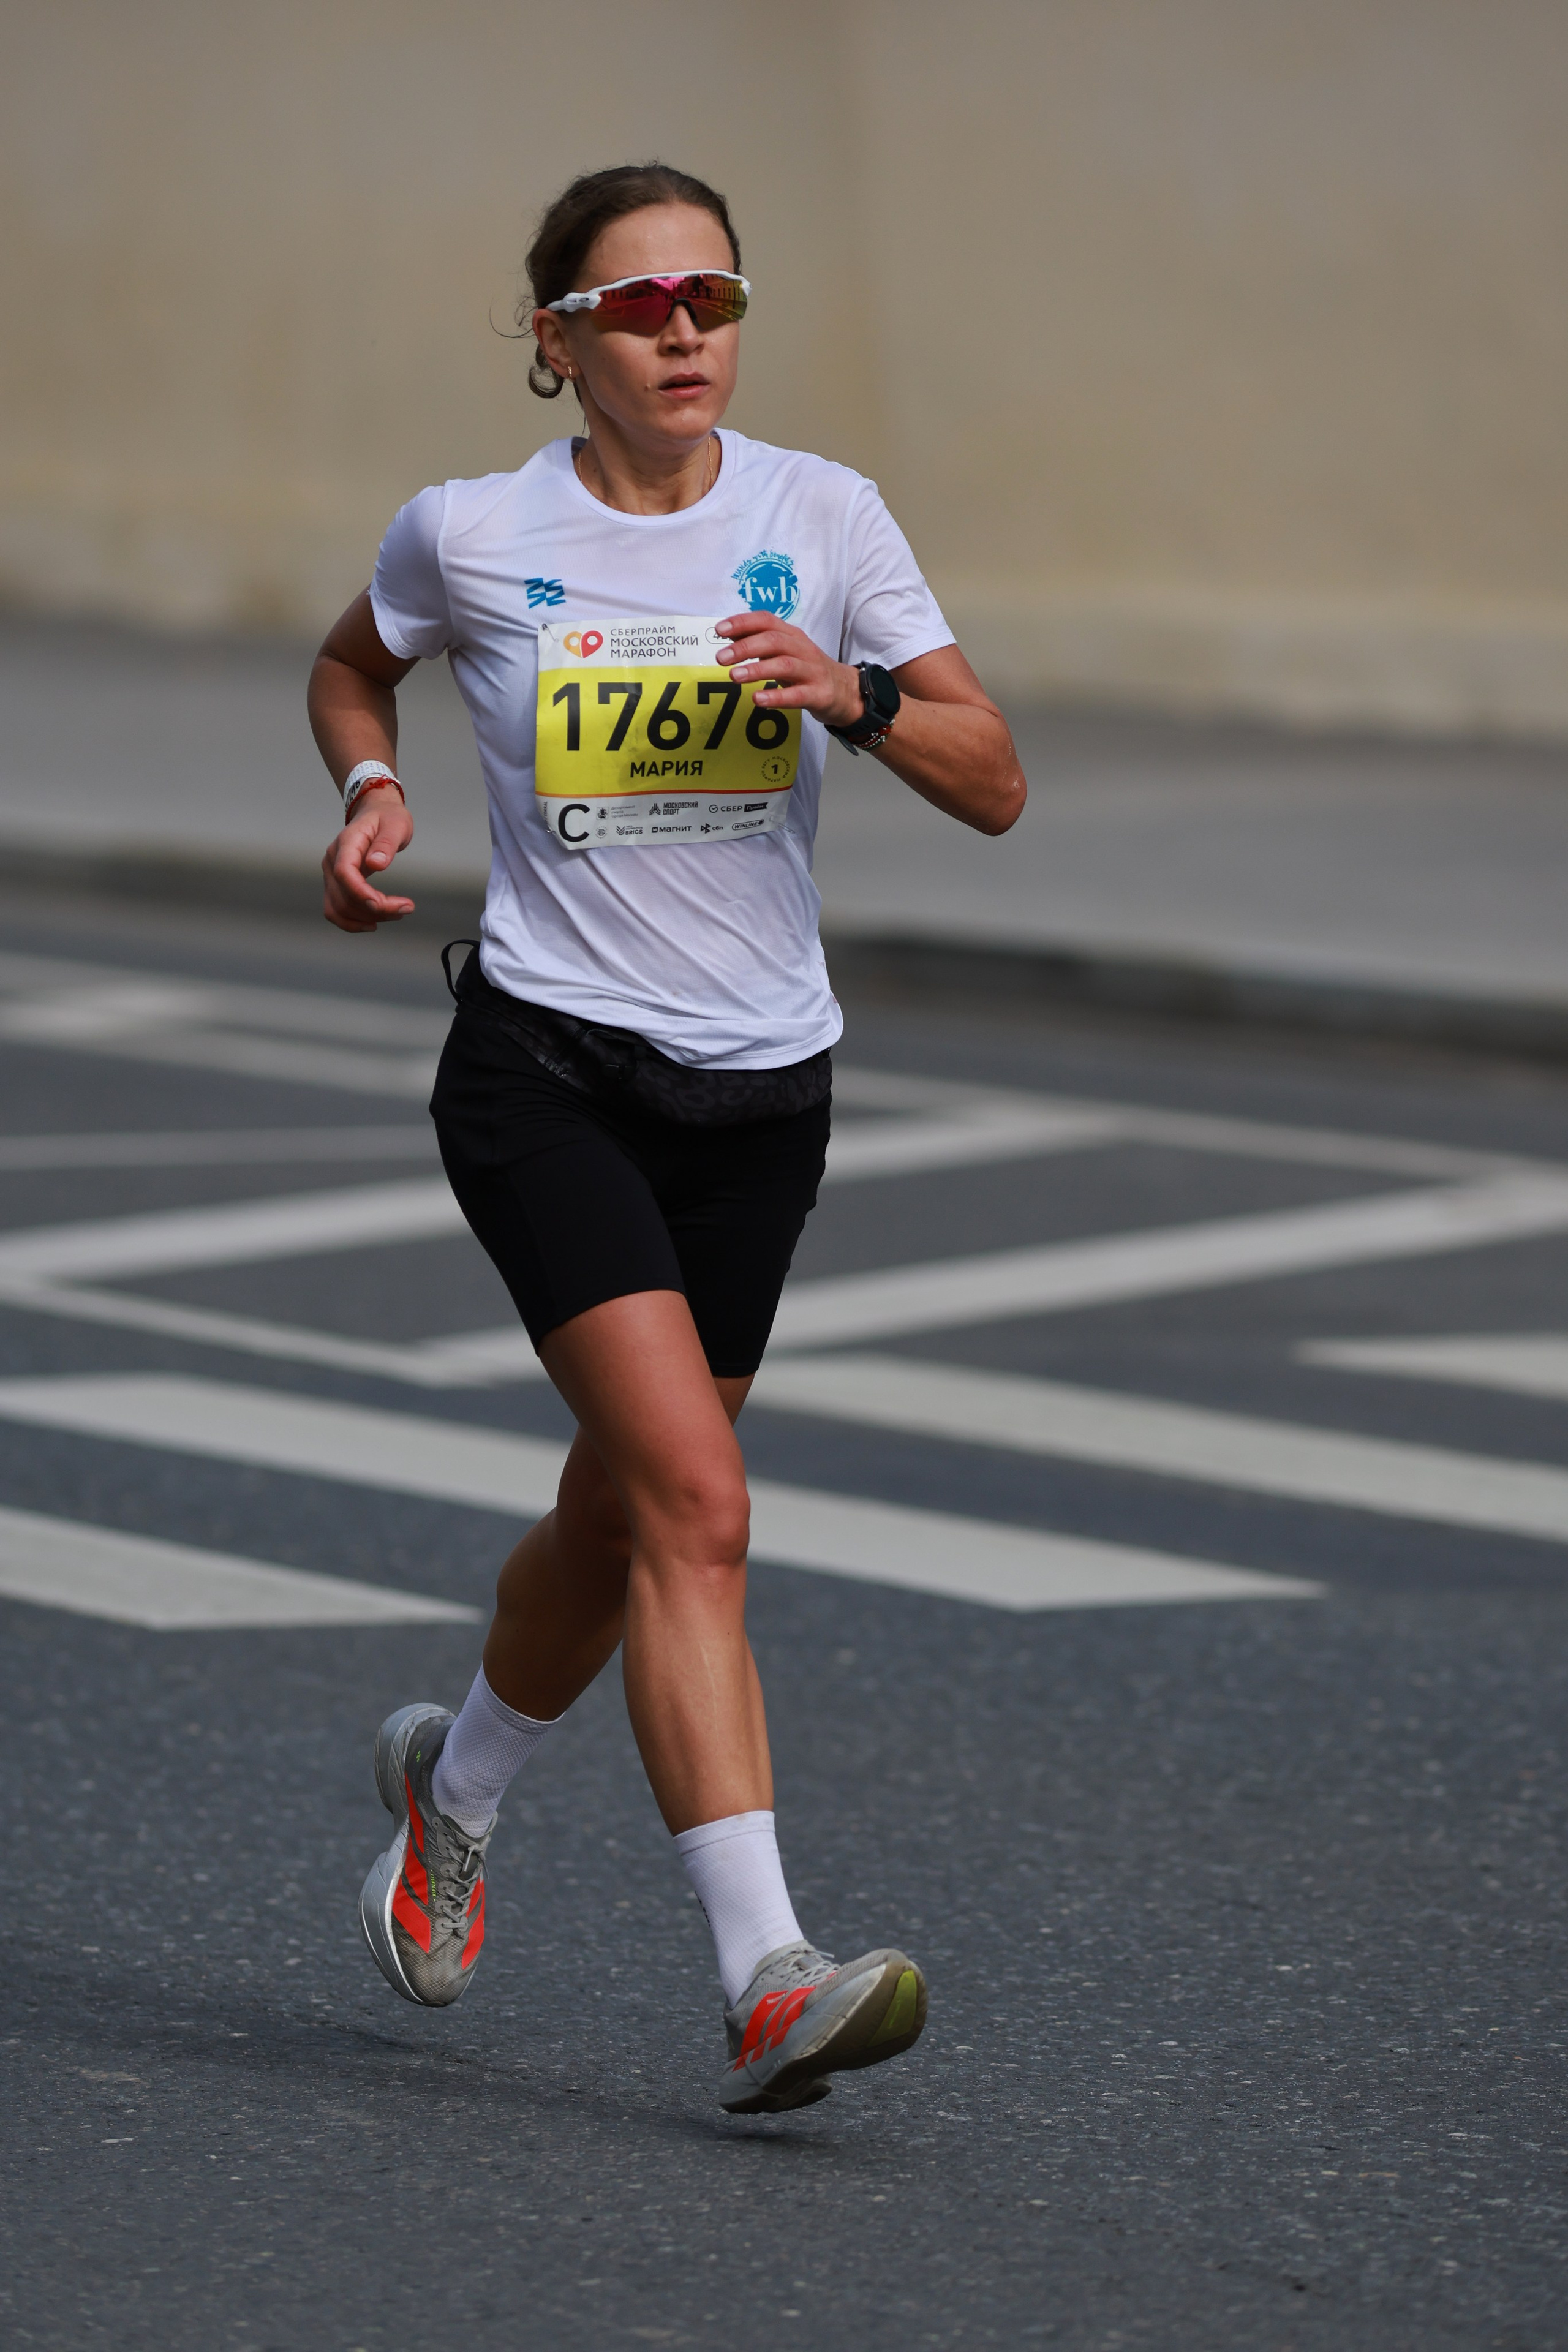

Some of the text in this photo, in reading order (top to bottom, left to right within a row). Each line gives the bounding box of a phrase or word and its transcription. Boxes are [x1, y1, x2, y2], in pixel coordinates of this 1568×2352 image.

[742, 576, 797, 603] fwb
[611, 625, 676, 636] СБЕРПРАЙМ
[611, 635, 698, 647] МОСКОВСКИЙ
[611, 647, 676, 658] МАРАФОН
[552, 681, 790, 752] 17676
[630, 760, 703, 778] МАРИЯ
[771, 764, 778, 774] 1
